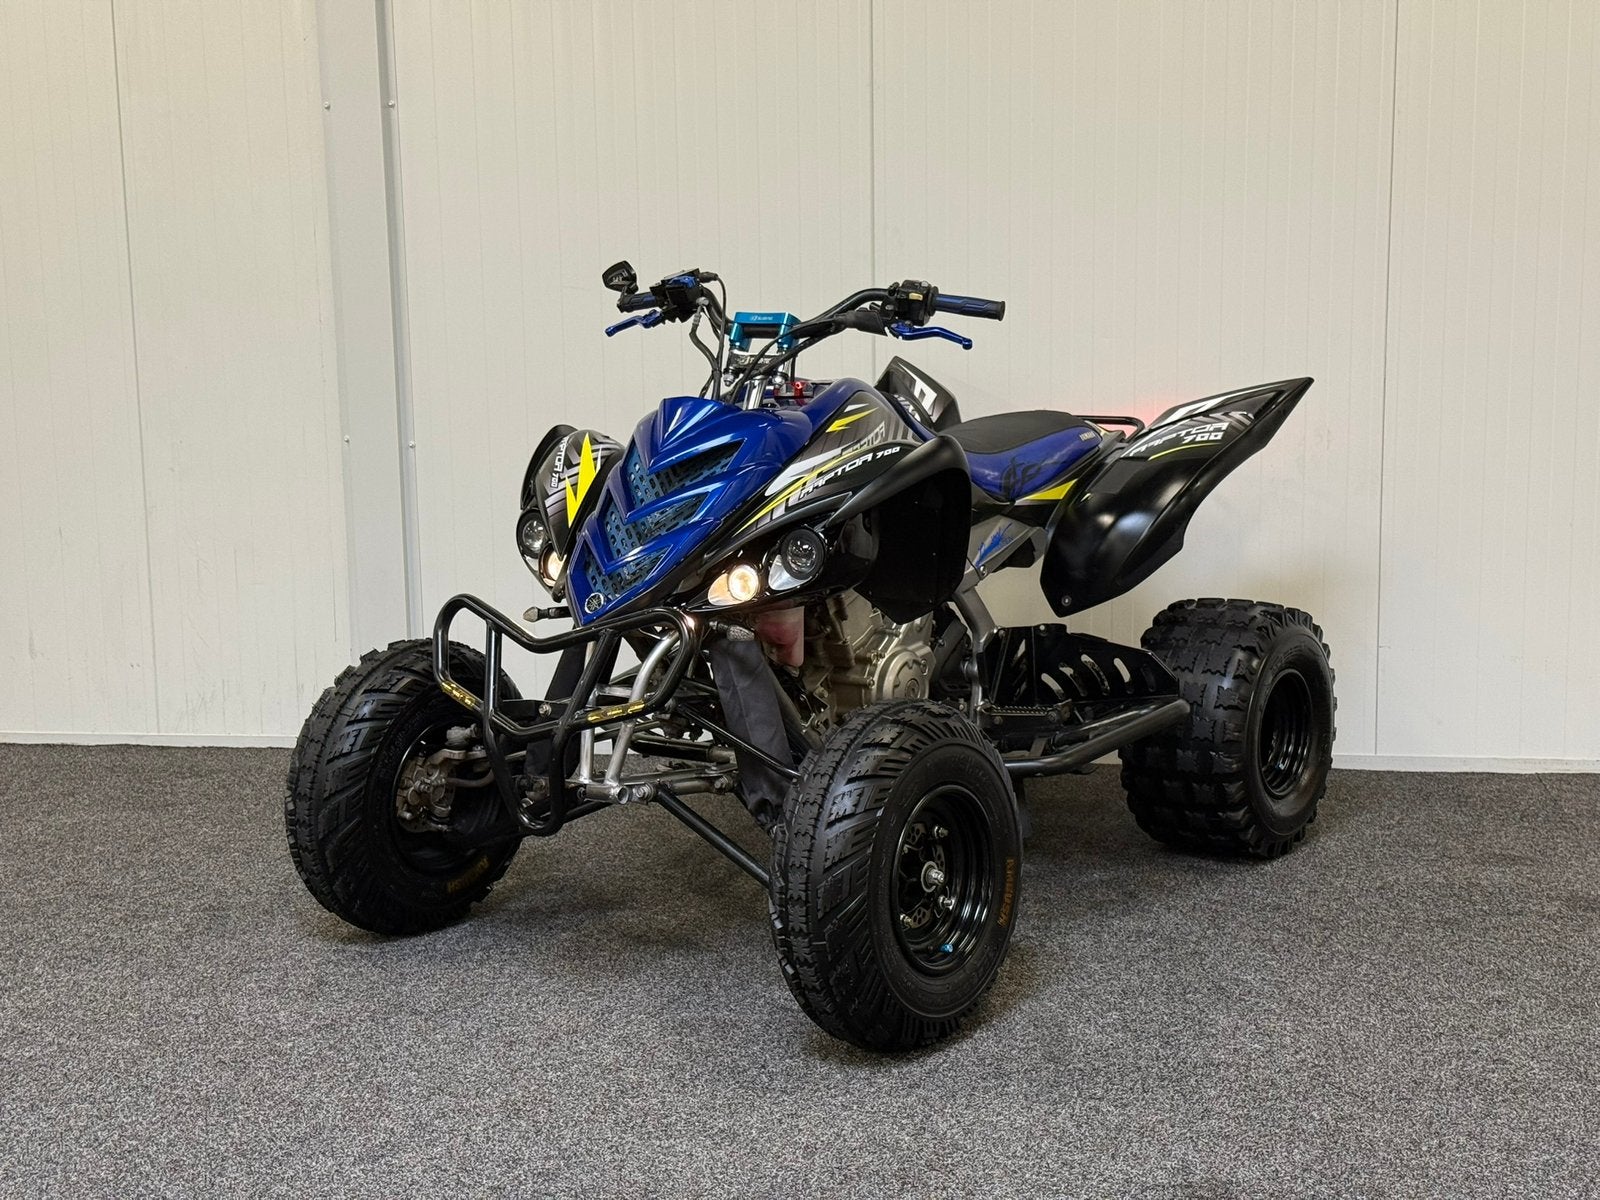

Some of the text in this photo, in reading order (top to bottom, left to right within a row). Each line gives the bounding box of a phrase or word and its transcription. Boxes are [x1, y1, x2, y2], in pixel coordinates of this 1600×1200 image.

[1129, 422, 1231, 457] RAPTOR
[1182, 431, 1224, 444] 700
[799, 446, 901, 499] RAPTOR 700
